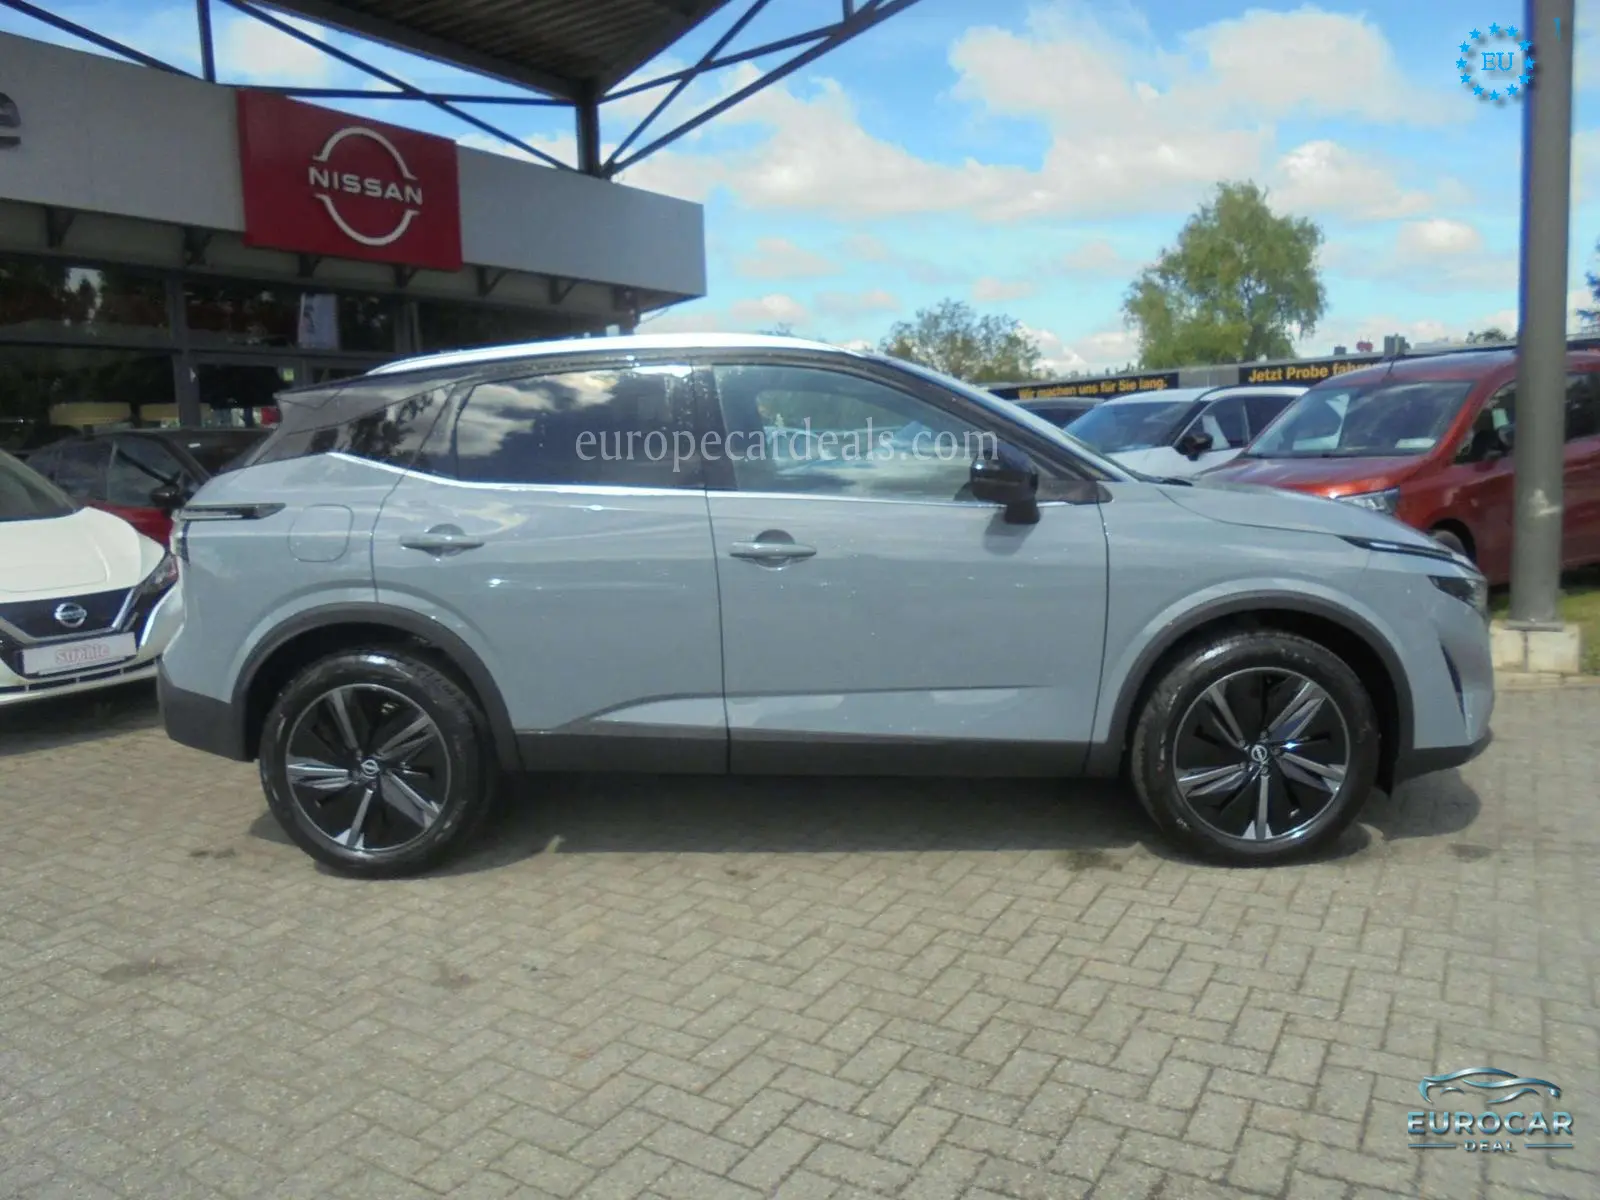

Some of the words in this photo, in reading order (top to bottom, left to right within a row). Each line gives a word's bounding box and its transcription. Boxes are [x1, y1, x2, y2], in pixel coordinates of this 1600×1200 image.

[308, 166, 423, 205] NISSAN
[1248, 367, 1282, 383] Jetzt
[1286, 364, 1328, 379] Probe
[1332, 361, 1377, 376] fah
[1079, 384, 1098, 394] uns
[1100, 381, 1116, 393] für
[1119, 379, 1136, 391] Sie
